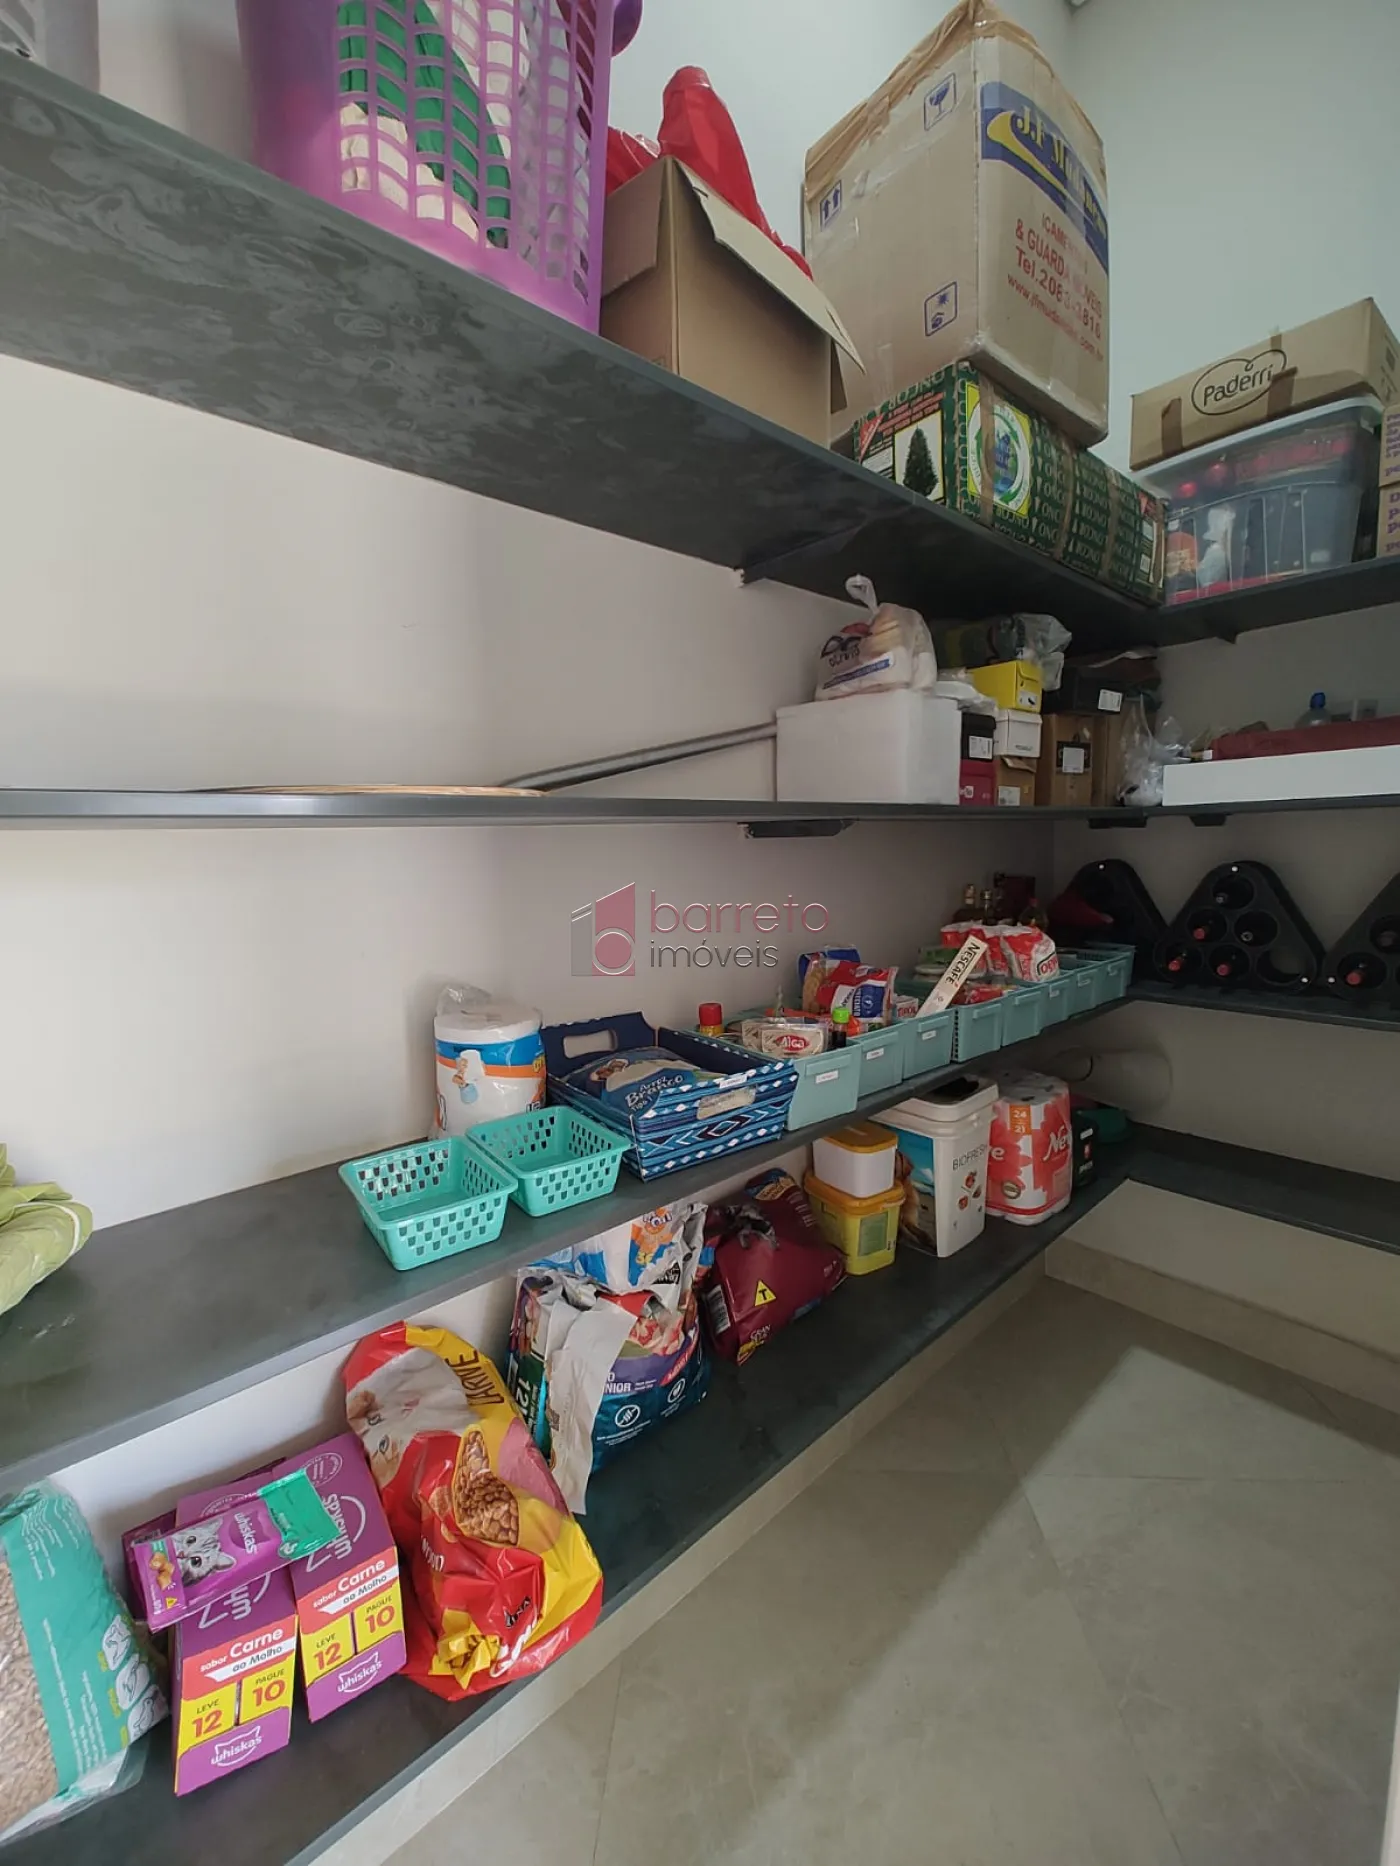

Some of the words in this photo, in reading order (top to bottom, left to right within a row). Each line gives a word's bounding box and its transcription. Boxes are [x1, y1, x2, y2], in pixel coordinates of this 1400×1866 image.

[1015, 218, 1024, 241] &
[625, 1074, 683, 1107] Branco
[1013, 1109, 1027, 1119] 24
[234, 1512, 258, 1555] whiskas
[338, 1560, 386, 1592] Carne
[343, 1593, 356, 1604] ao
[358, 1575, 387, 1596] Molho
[365, 1605, 395, 1633] 10
[366, 1596, 393, 1614] PAGUE
[200, 1655, 227, 1672] sabor
[230, 1628, 284, 1658] Carne
[316, 1633, 337, 1649] LEVE
[232, 1661, 246, 1672] ao
[250, 1645, 282, 1665] Molho
[313, 1642, 342, 1671] 12
[255, 1668, 285, 1685] PAGUE
[338, 1660, 382, 1692] whiskas
[196, 1698, 220, 1715] LEVE
[252, 1679, 286, 1707] 10
[191, 1709, 223, 1738] 12
[211, 1735, 262, 1765] whiskas
